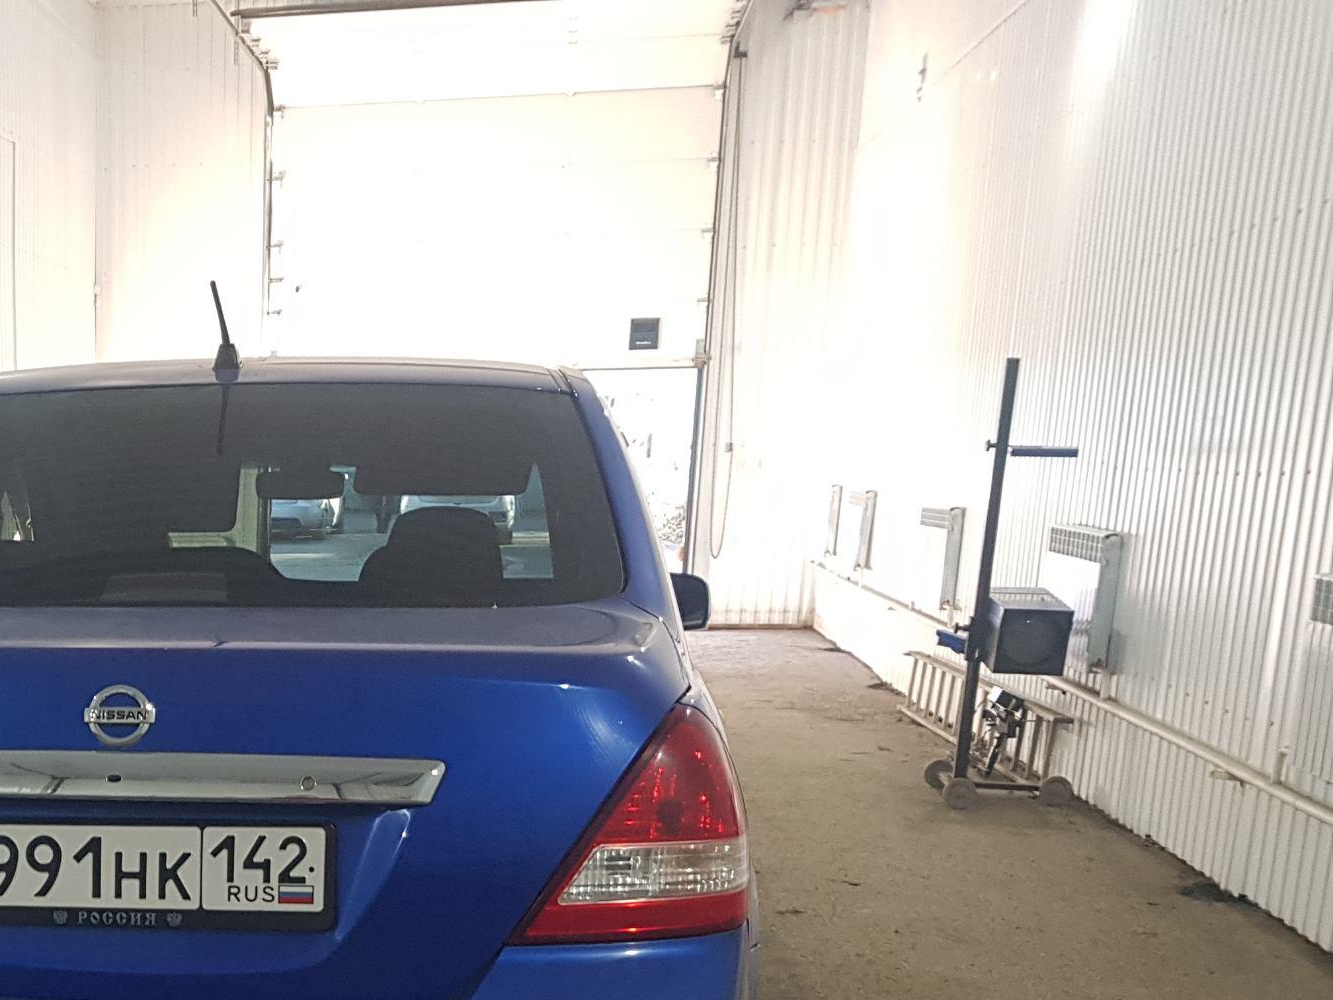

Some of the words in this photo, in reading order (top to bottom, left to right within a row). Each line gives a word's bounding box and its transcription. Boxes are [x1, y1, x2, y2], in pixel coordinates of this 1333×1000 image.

[90, 709, 147, 721] NISSAN
[210, 834, 308, 884] 142
[227, 885, 275, 903] RUS
[77, 910, 157, 926] РОССИЯ
